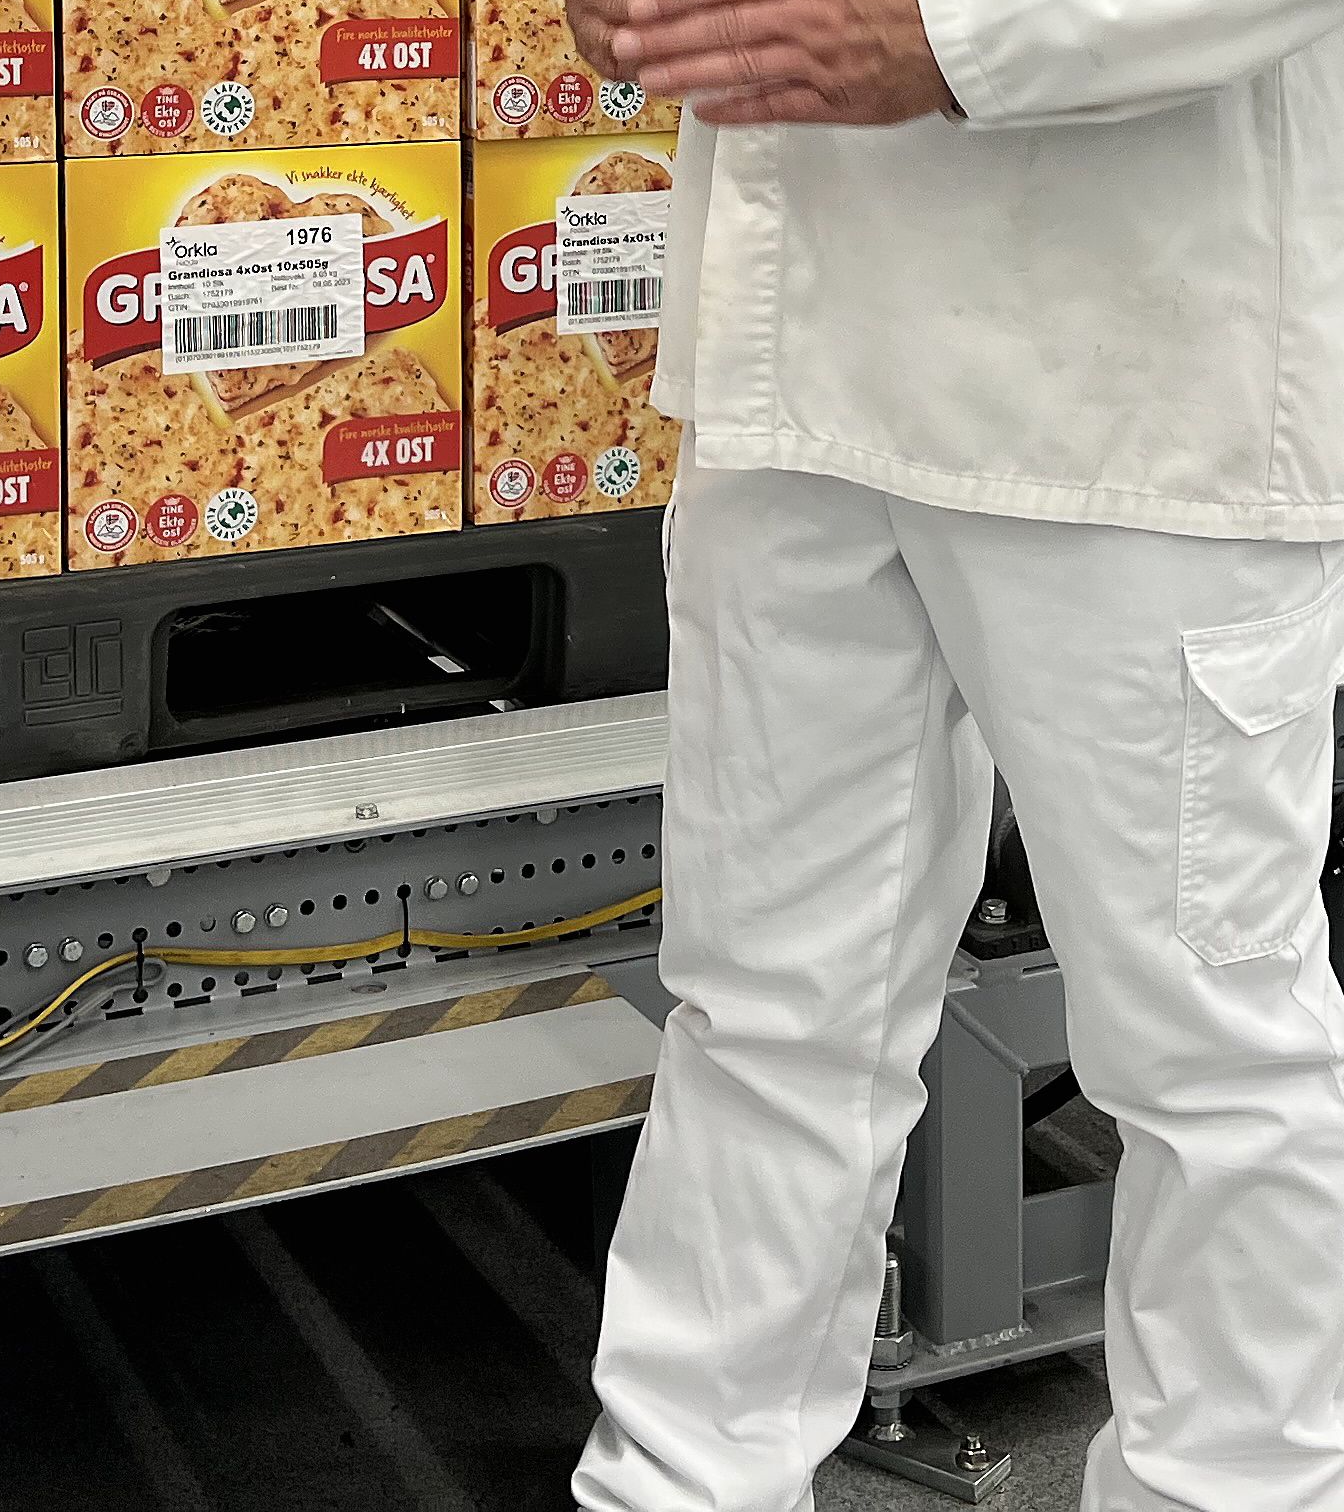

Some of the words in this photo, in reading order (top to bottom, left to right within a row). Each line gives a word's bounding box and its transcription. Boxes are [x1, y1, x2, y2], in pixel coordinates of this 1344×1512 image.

[337, 28, 355, 43] Fire
[358, 43, 387, 69] 4X
[393, 42, 432, 68] OST
[214, 85, 241, 95] LAVT
[156, 96, 179, 104] TINE
[559, 93, 581, 104] Ekte
[155, 106, 180, 117] Ekte
[159, 118, 176, 127] ost
[286, 170, 298, 184] Vi
[347, 170, 368, 186] ekte
[370, 177, 415, 220] kjærlighet
[569, 212, 606, 226] Orkla
[286, 227, 332, 245] 1976
[563, 236, 619, 247] Grandiosa
[623, 233, 654, 243] 4xOst
[175, 243, 217, 258] Orkla
[168, 268, 232, 281] Grandiosa
[236, 264, 272, 276] 4xOst
[277, 260, 328, 272] 10x505g
[339, 427, 357, 442] Fire
[361, 440, 390, 467] 4X
[396, 436, 434, 464] OST
[554, 474, 576, 485] Ekte
[218, 491, 244, 502] LAVT
[160, 505, 183, 513] TINE
[159, 516, 184, 528] Ekte
